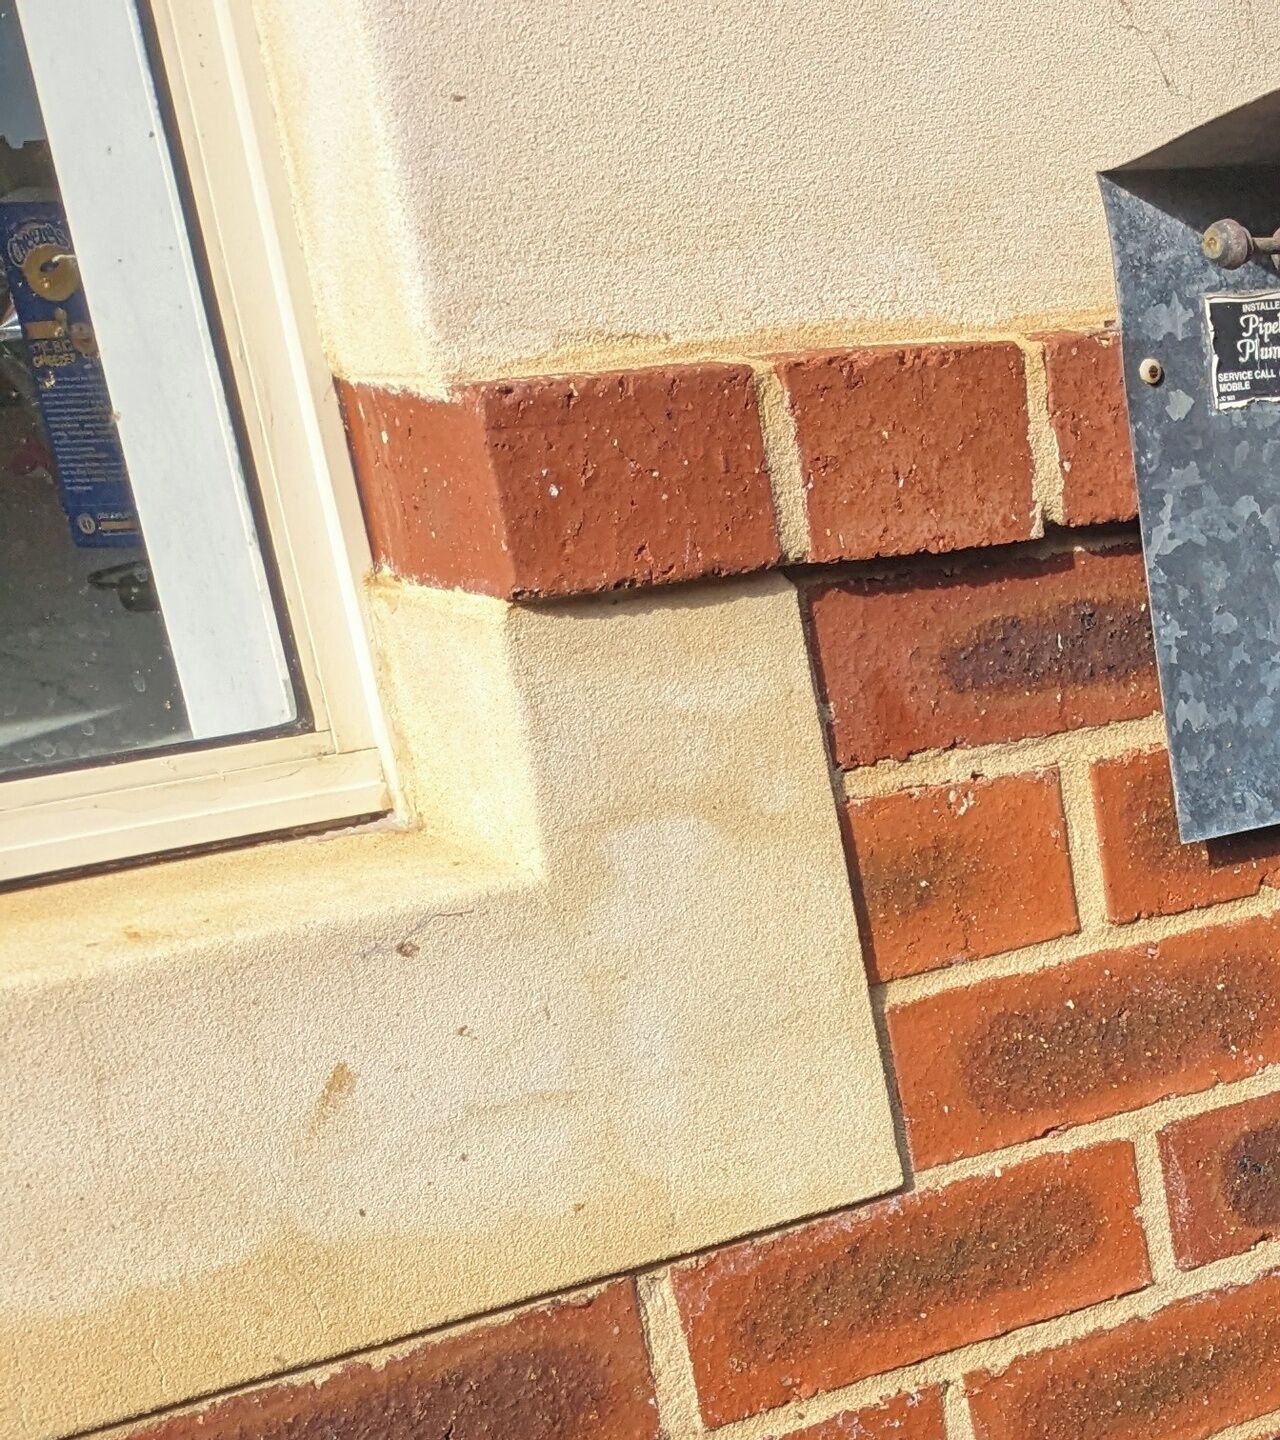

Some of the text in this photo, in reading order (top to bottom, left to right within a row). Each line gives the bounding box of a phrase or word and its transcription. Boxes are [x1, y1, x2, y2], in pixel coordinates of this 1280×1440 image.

[1218, 370, 1254, 382] SERVICE
[1254, 369, 1276, 380] CALL
[1219, 381, 1250, 393] MOBILE
